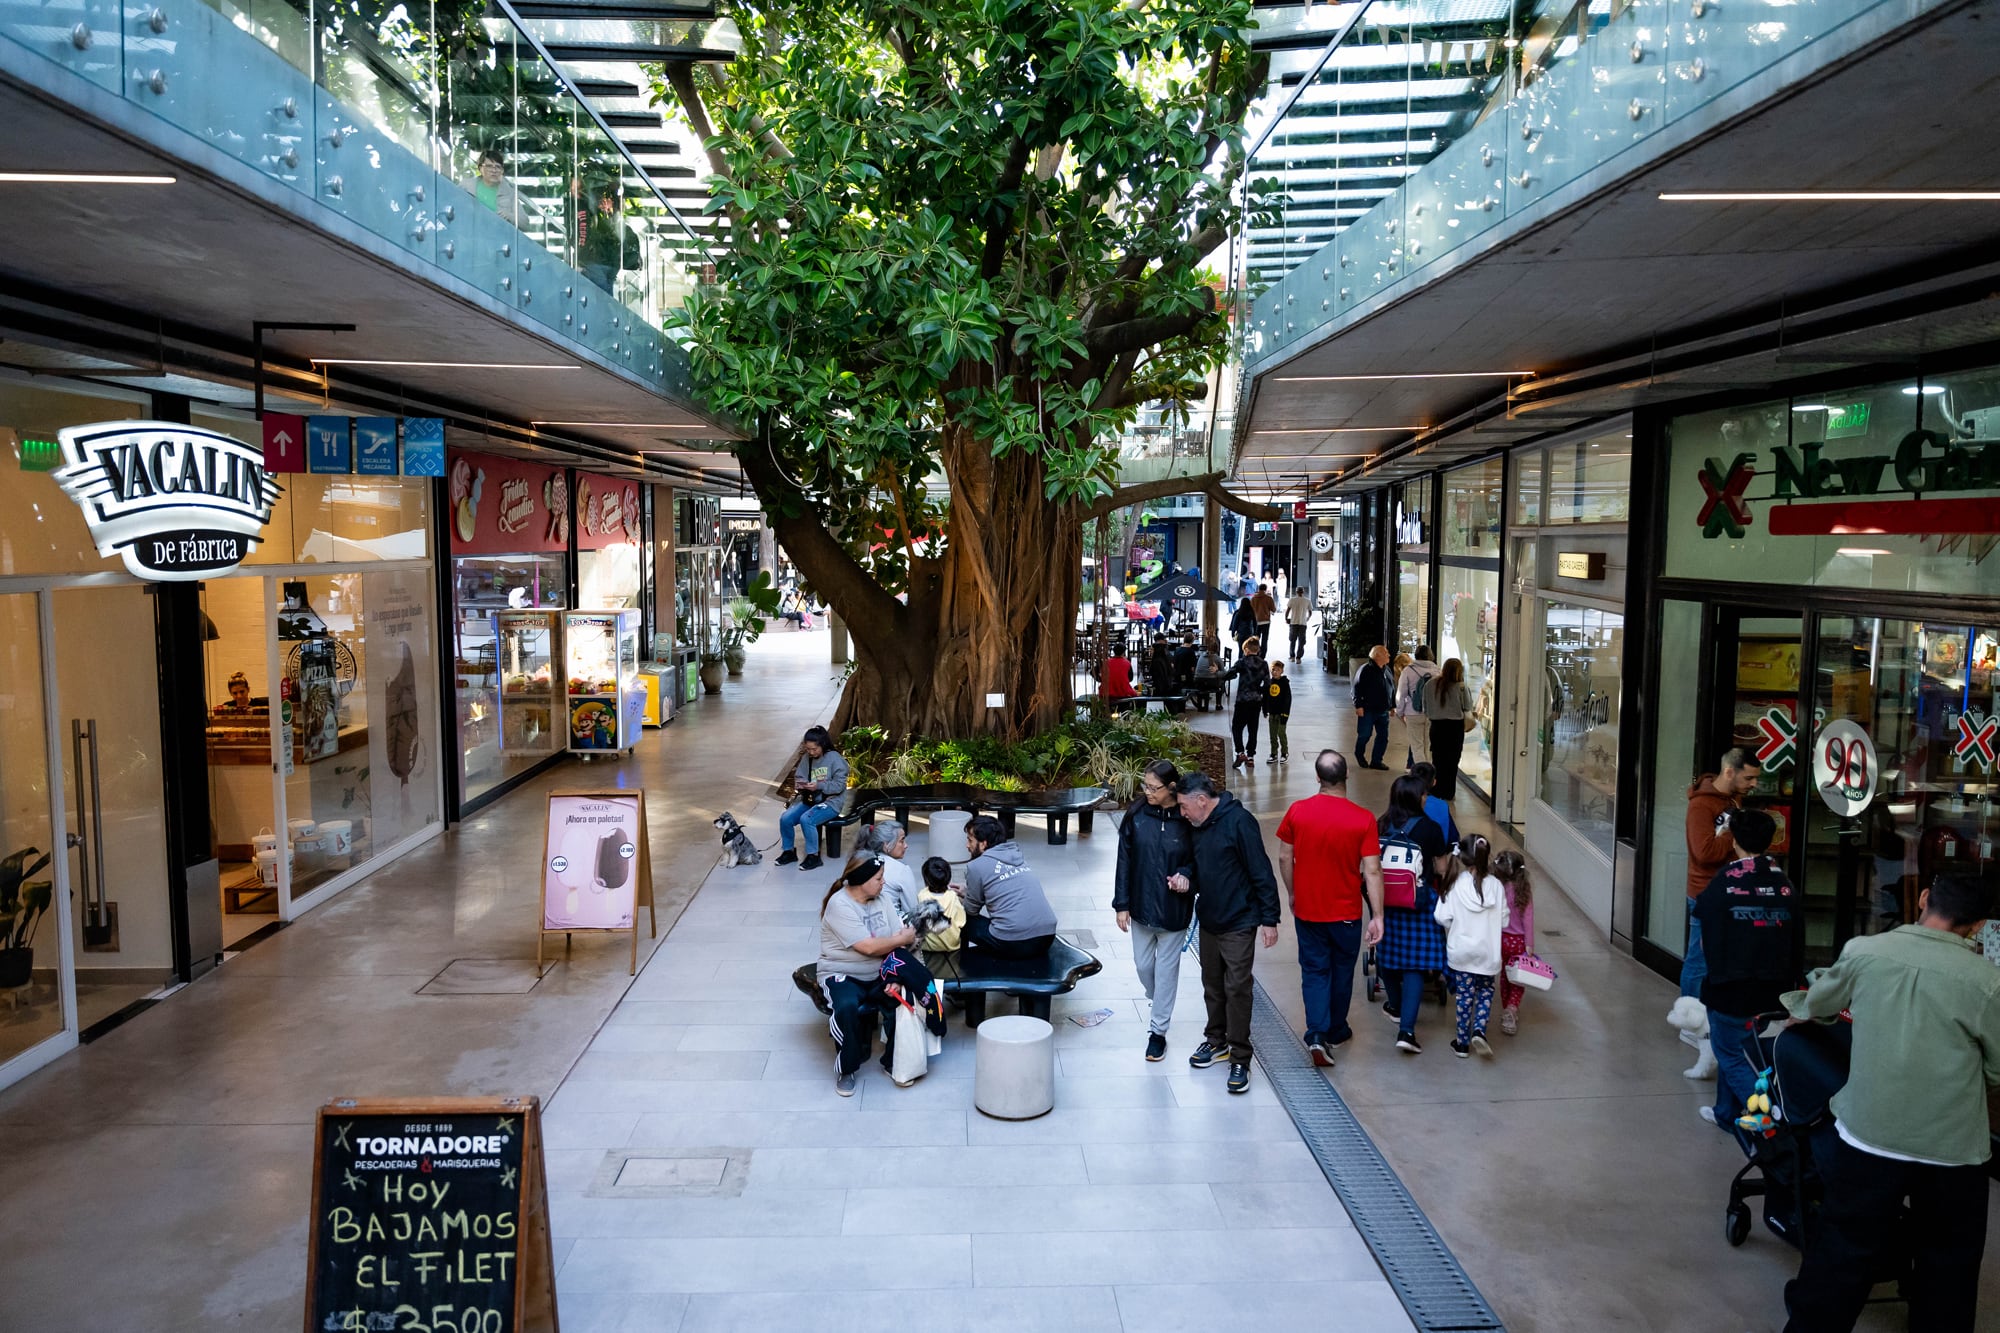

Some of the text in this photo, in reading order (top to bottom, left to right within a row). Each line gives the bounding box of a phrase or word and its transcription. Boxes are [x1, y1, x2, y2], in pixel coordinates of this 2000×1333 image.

[94, 441, 263, 511] VACALIN
[1770, 442, 1890, 499] New
[305, 665, 329, 682] PIZZA
[1824, 737, 1868, 789] 90
[565, 814, 587, 826] ¡Ahora
[404, 1124, 432, 1133] DESDE
[356, 1135, 502, 1156] TORNADORE
[354, 1159, 418, 1170] PESCADERIAS
[433, 1158, 501, 1169] MARISQUERIAS
[328, 1206, 516, 1244] BAJAMOS
[356, 1255, 401, 1288] EL
